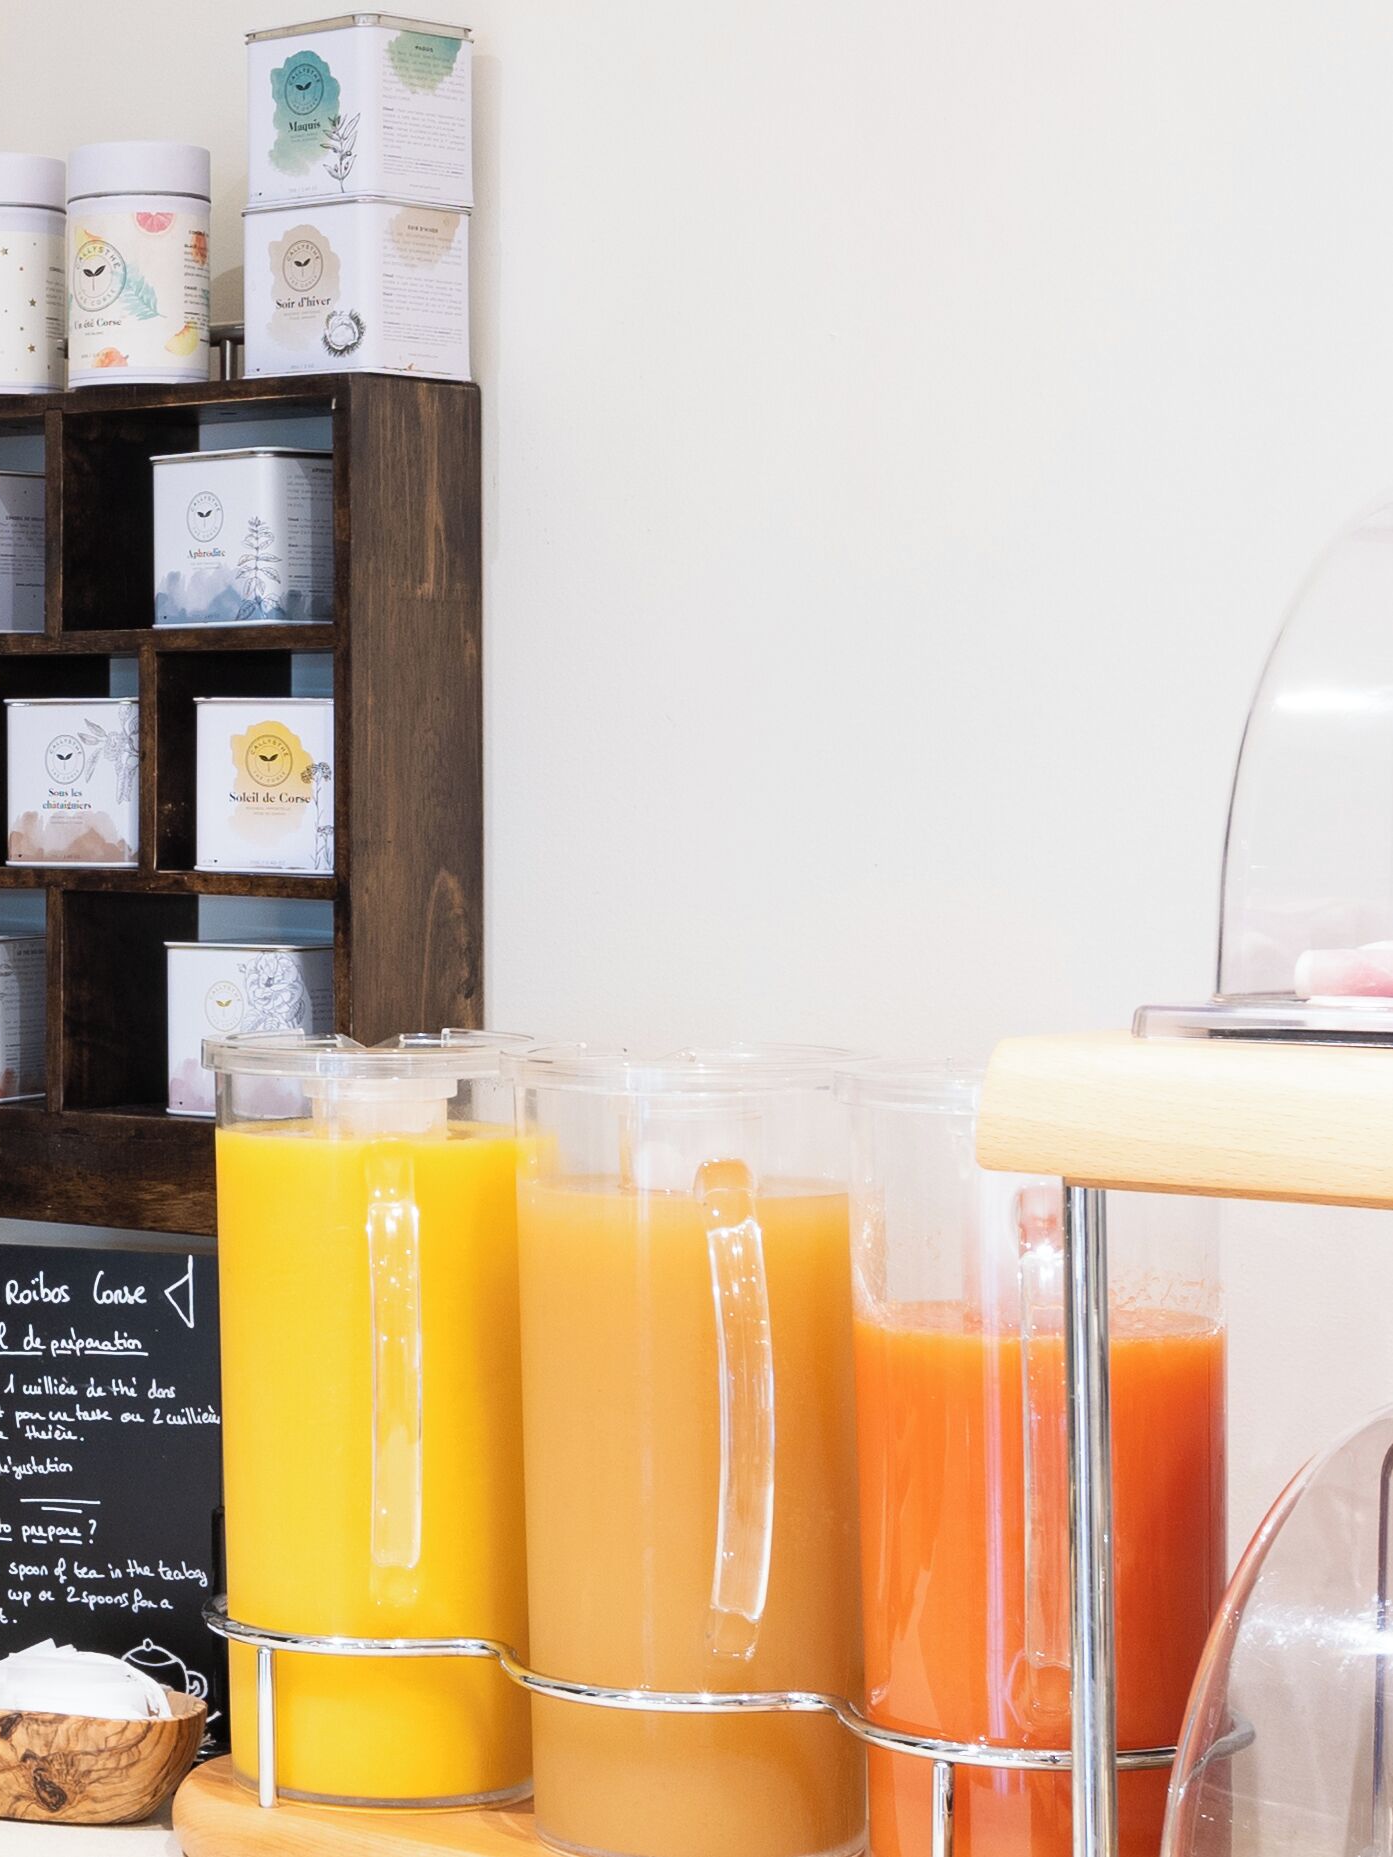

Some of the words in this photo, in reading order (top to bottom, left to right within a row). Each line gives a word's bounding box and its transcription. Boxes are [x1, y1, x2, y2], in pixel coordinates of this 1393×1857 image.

[288, 119, 321, 133] Maquis
[275, 298, 295, 310] Soir
[298, 295, 331, 309] d'hiver
[96, 317, 122, 328] Corse
[49, 788, 68, 797] Sous
[71, 787, 83, 797] les
[228, 791, 259, 803] Soleil
[262, 792, 276, 803] de
[279, 792, 311, 804] Corse
[93, 1270, 148, 1305] Corse
[23, 1323, 47, 1351] de
[50, 1327, 143, 1357] préparation
[3, 1373, 15, 1394] 1
[86, 1377, 107, 1398] de
[111, 1377, 138, 1398] thé
[147, 1378, 176, 1399] dans
[14, 1410, 47, 1428] pour
[48, 1410, 75, 1422] une
[75, 1403, 113, 1421] tasse
[120, 1412, 146, 1423] ou
[152, 1408, 164, 1425] 2
[21, 1525, 82, 1543] prepare
[8, 1561, 49, 1582] spoon
[54, 1557, 68, 1584] of
[74, 1561, 106, 1579] tea
[107, 1563, 122, 1579] in
[126, 1559, 155, 1578] the
[158, 1559, 209, 1588] teabag
[8, 1589, 32, 1608] cup
[38, 1590, 55, 1602] or
[66, 1586, 81, 1603] 2
[81, 1590, 129, 1611] spoons
[131, 1588, 158, 1614] for
[160, 1598, 174, 1610] a
